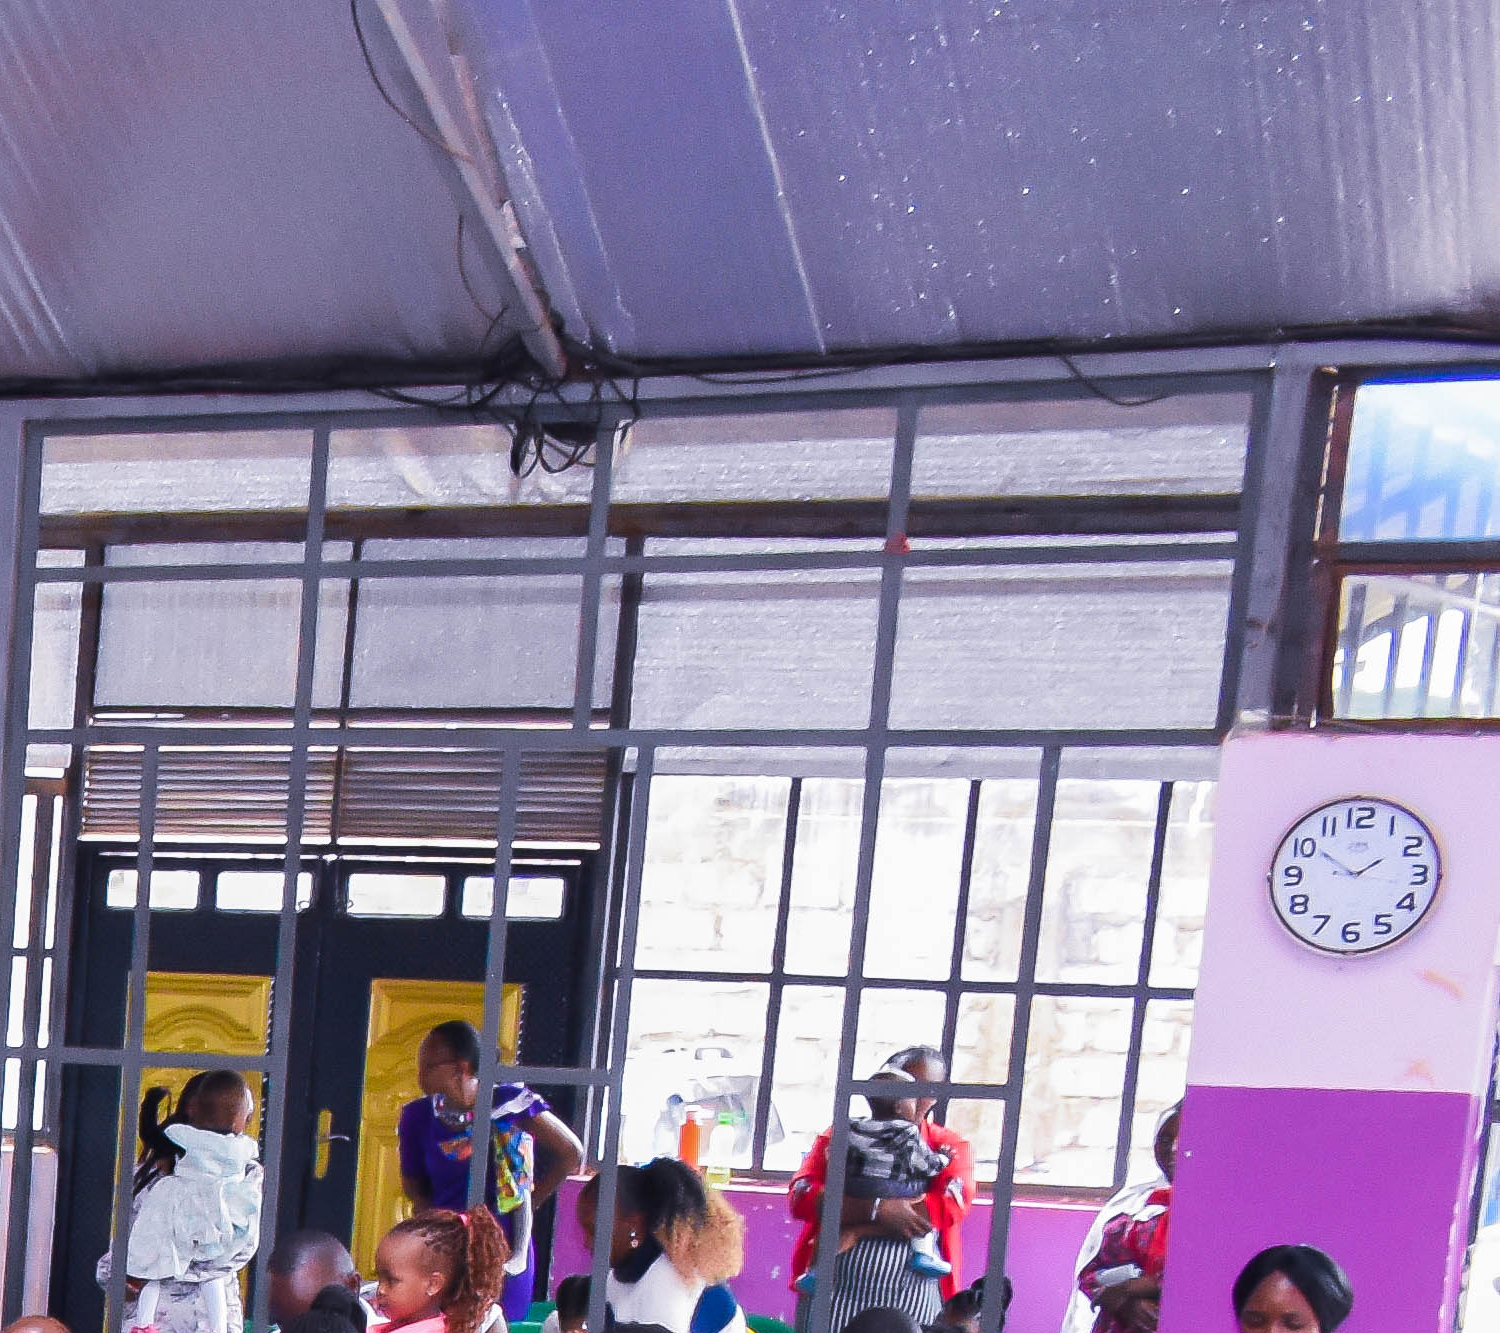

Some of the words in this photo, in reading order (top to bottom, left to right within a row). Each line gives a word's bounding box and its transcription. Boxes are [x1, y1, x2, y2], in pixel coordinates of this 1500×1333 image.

[1321, 815, 1337, 837] 11
[1346, 806, 1376, 830] 12
[1389, 815, 1396, 837] 1
[1293, 837, 1317, 859] 10
[1402, 835, 1423, 858] 2
[1283, 865, 1303, 887] 9
[1409, 864, 1429, 886] 3
[1289, 893, 1310, 915] 8
[1395, 892, 1416, 913] 4
[1312, 914, 1332, 936] 7
[1340, 922, 1361, 944] 6
[1373, 913, 1394, 936] 5
